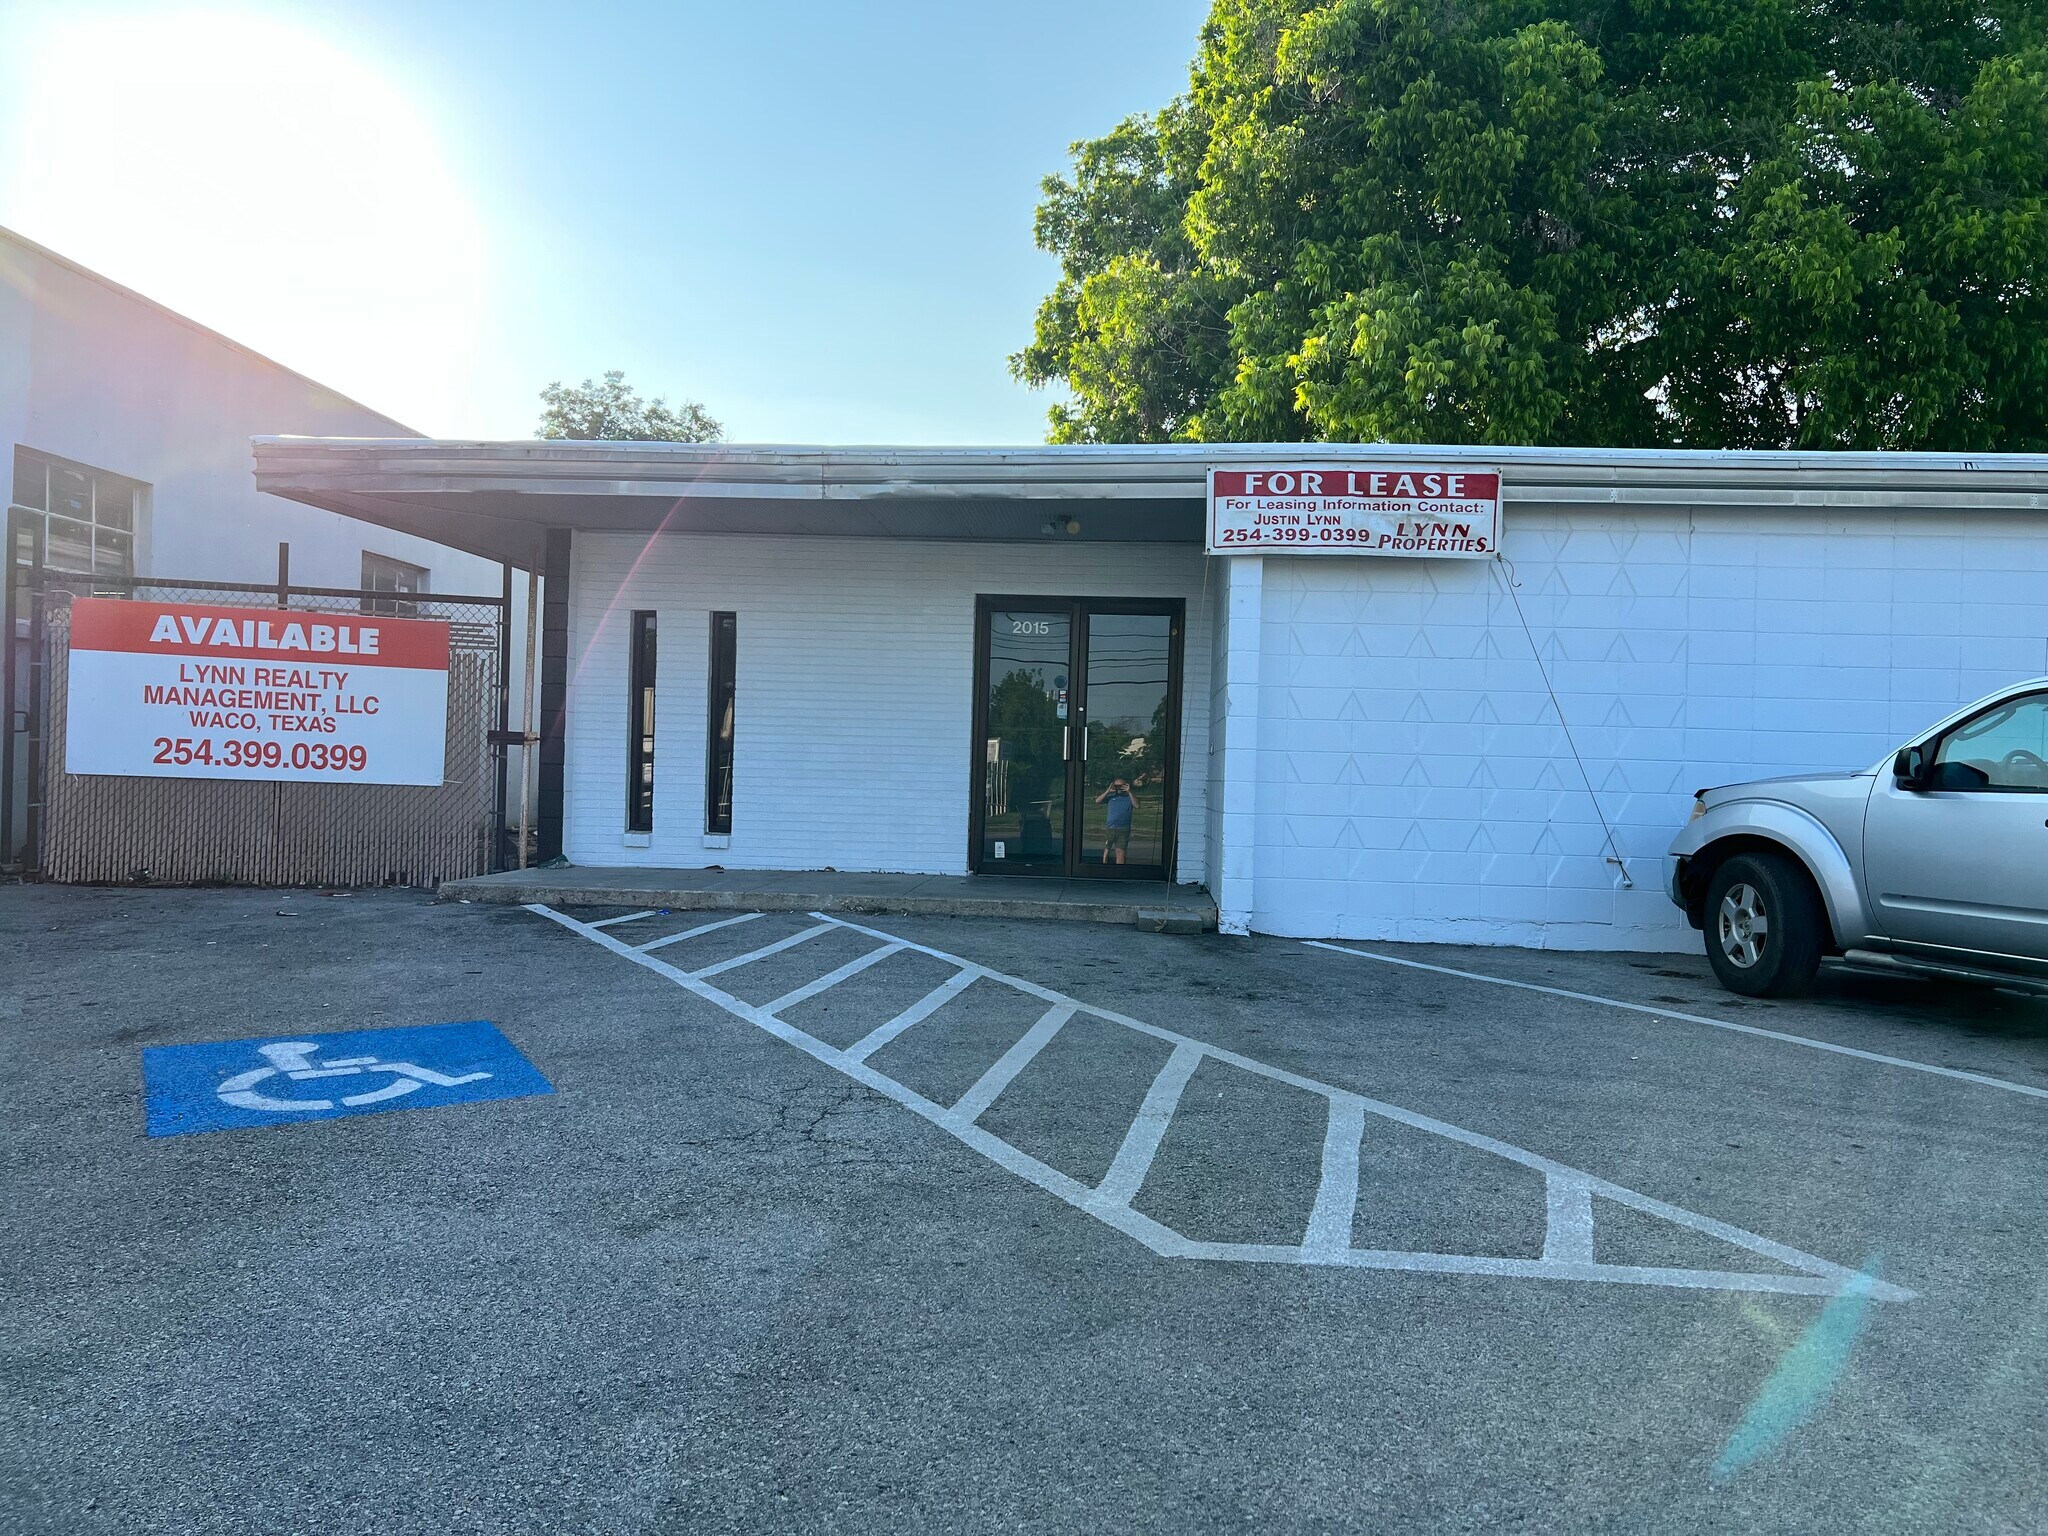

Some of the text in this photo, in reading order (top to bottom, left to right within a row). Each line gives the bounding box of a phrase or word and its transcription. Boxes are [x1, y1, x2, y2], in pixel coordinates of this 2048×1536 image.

[1245, 473, 1465, 497] FOR LEASE
[1226, 499, 1484, 513] For Leasing Information Contact:
[1254, 513, 1341, 525] JUSTIN LYNN
[1223, 528, 1369, 542] 254-399-0399
[1397, 523, 1470, 537] LYNN
[1378, 535, 1487, 552] PROPERTIES
[149, 614, 380, 655] AVAILABLE
[1013, 621, 1049, 634] 2015
[180, 664, 349, 690] LYNN REALTY
[144, 685, 379, 716] MANAGEMENT, LLC
[190, 711, 336, 733] WACO, TEXAS
[153, 737, 367, 771] 254.399.0399
